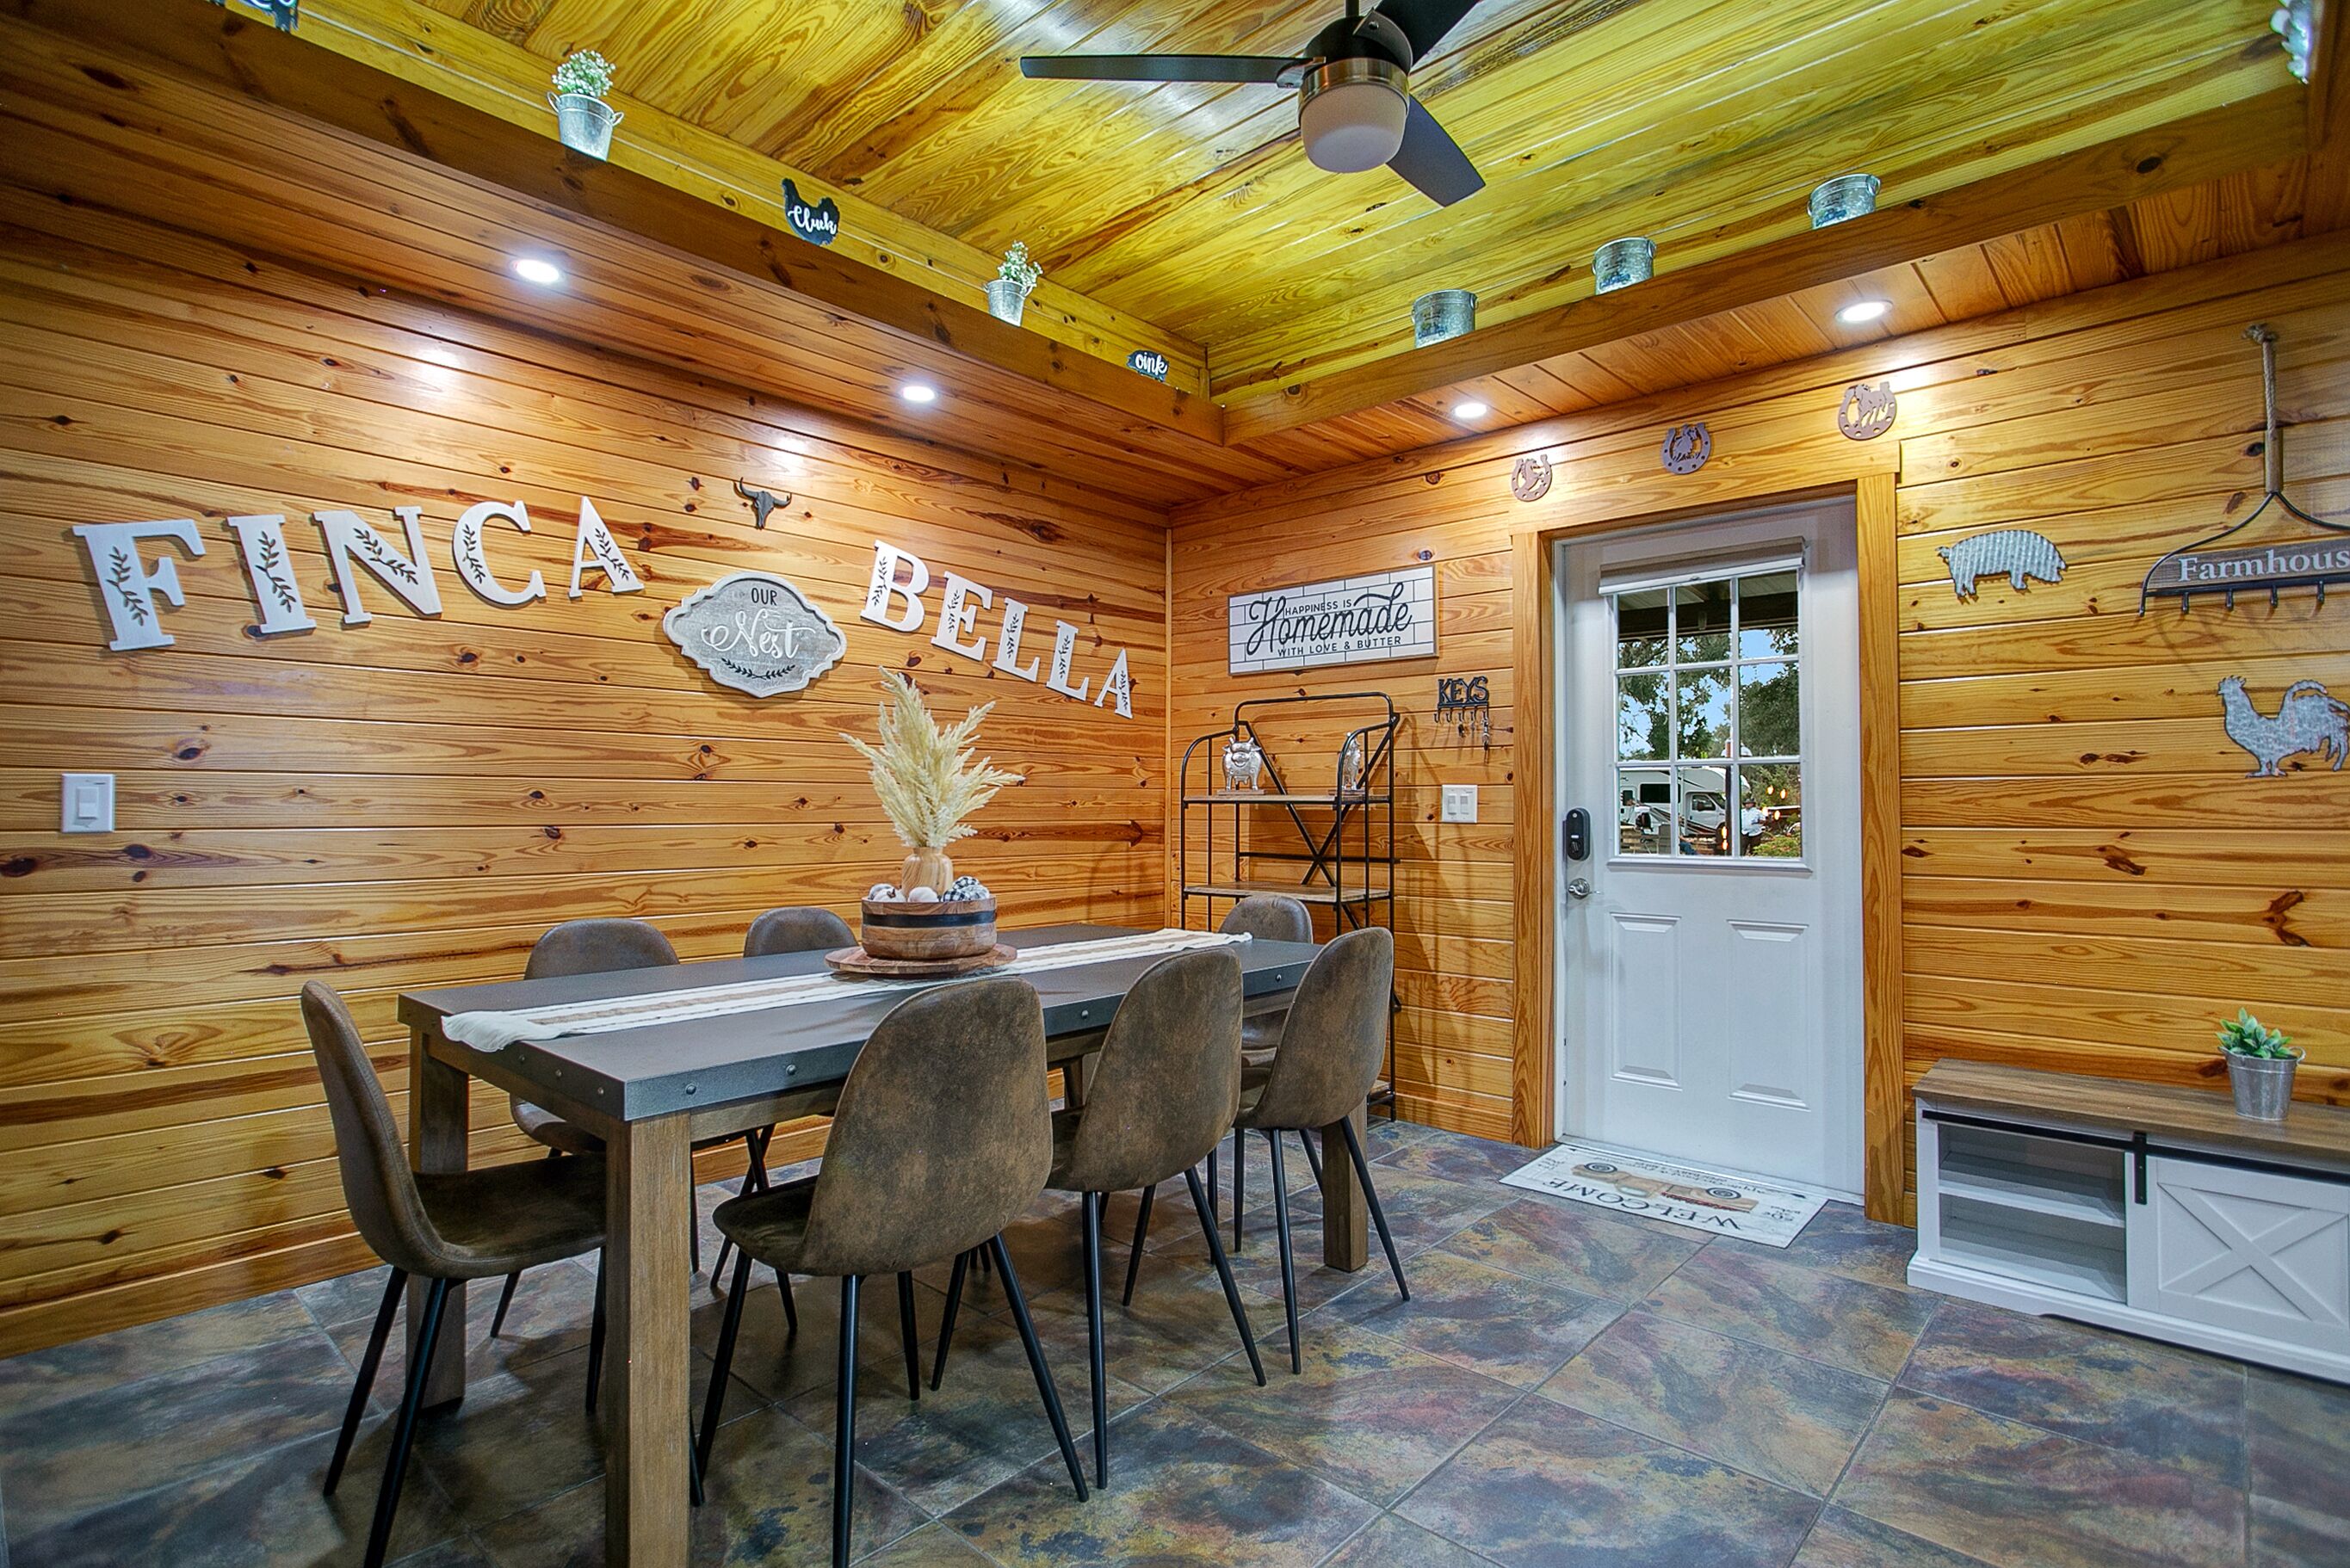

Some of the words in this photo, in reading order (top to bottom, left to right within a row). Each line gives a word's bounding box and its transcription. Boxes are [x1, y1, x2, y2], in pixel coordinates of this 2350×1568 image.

[72, 496, 645, 652] FINCA
[860, 540, 1134, 719] BELLA
[751, 588, 778, 606] OUR
[1284, 601, 1339, 616] HAPPINESS
[1343, 599, 1352, 608] IS
[701, 608, 816, 658] Nest
[1246, 582, 1413, 656] Homemade
[1277, 646, 1304, 657] WITH
[1309, 643, 1338, 654] LOVE
[1344, 641, 1351, 650] &
[1357, 636, 1401, 648] BUTTER
[1438, 676, 1489, 704] KEYS
[1543, 1177, 1741, 1231] WELCOME
